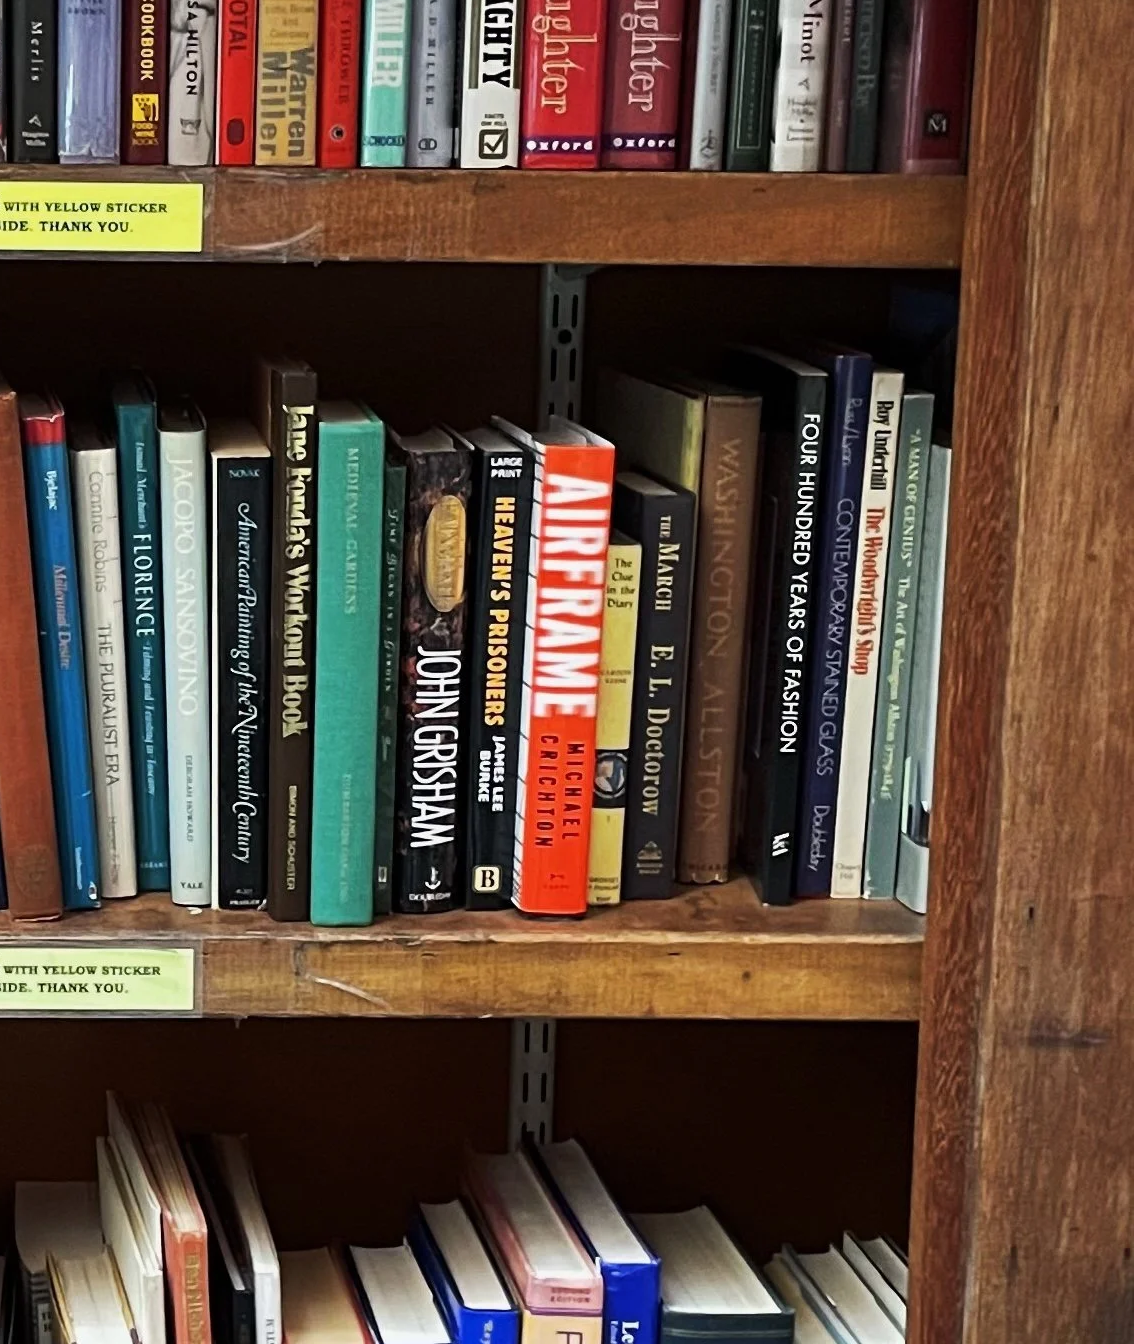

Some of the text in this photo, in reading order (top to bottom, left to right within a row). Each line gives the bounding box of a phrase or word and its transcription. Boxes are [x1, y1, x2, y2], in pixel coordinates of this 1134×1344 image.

[4, 202, 39, 212] WITH
[45, 202, 101, 213] YELLOW
[106, 203, 167, 213] STICKER
[39, 221, 92, 232] THANK
[99, 221, 133, 232] YOU.
[282, 406, 314, 736] Jane Fonda's Workout Book
[484, 497, 516, 726] HEAVEN'S PRISONERS
[534, 474, 608, 718] AIRFRAME
[779, 413, 821, 752] FOUR HUNDRED YEARS OF FASHION
[411, 645, 462, 847] JOHN GRISHAM
[478, 750, 492, 802] BURKE
[490, 735, 506, 812] JAMES LEE
[535, 735, 559, 848] CRICHTON
[562, 743, 585, 840] MICHAEL
[4, 966, 38, 975] WITH
[43, 966, 97, 975] YELLOW
[102, 966, 160, 976] STICKER
[38, 983, 89, 993] THANK
[94, 983, 128, 993] YOU.
